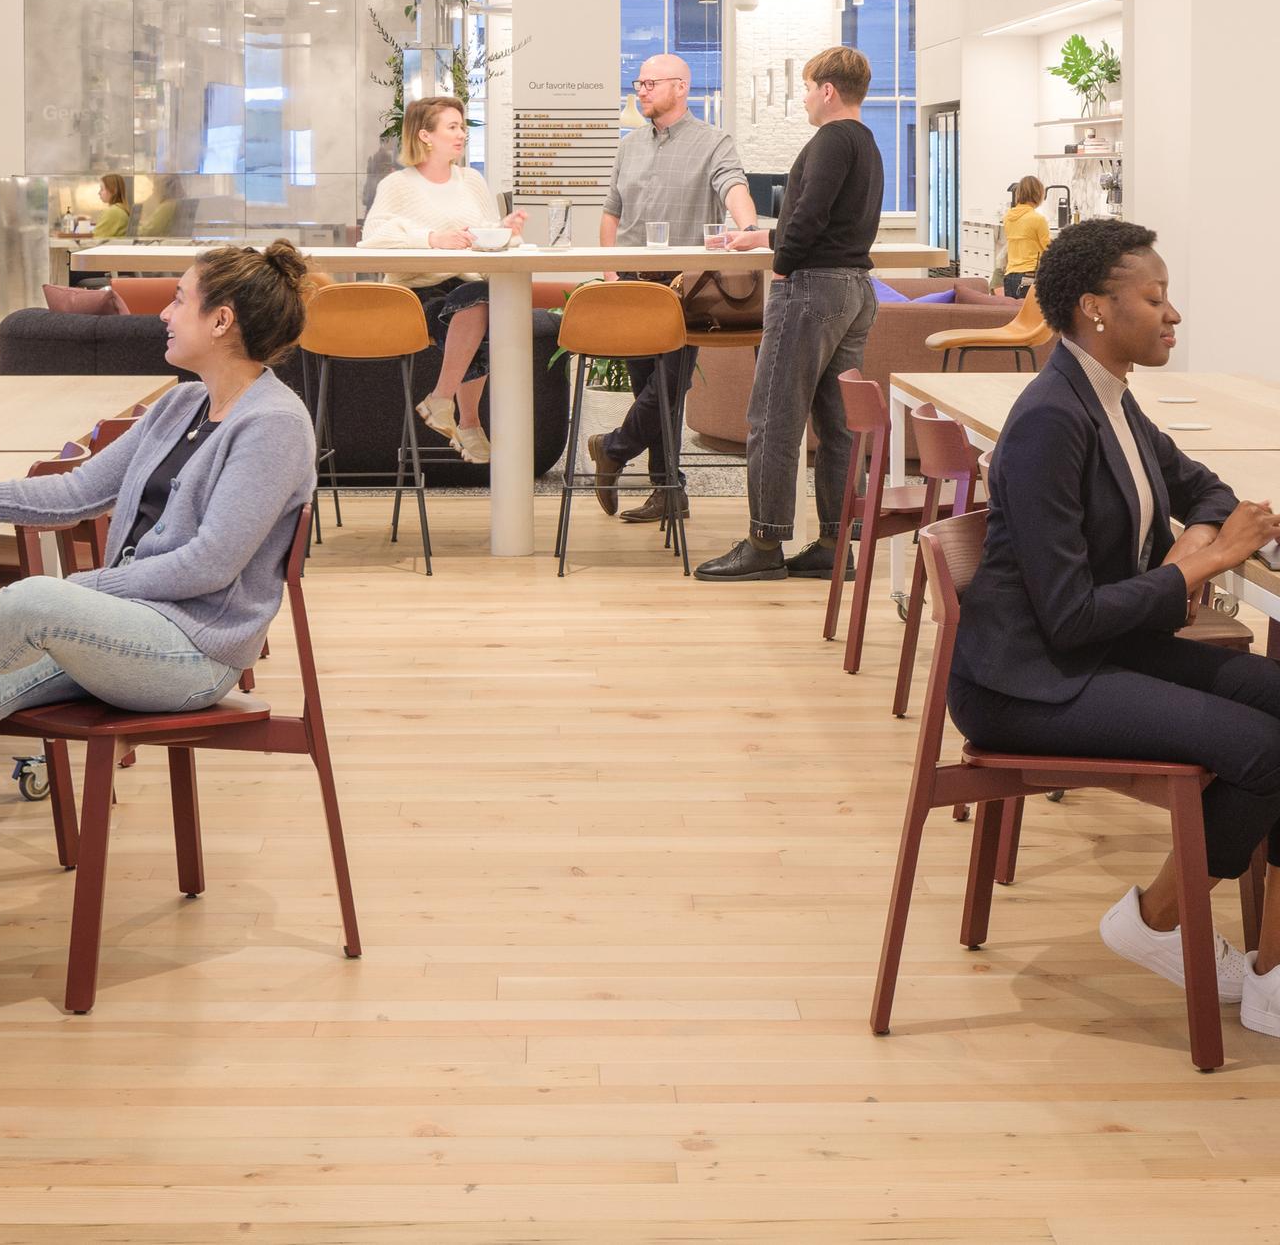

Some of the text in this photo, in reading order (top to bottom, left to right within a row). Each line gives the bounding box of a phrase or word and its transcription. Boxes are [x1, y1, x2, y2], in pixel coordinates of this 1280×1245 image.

[528, 81, 604, 91] Our favorite places
